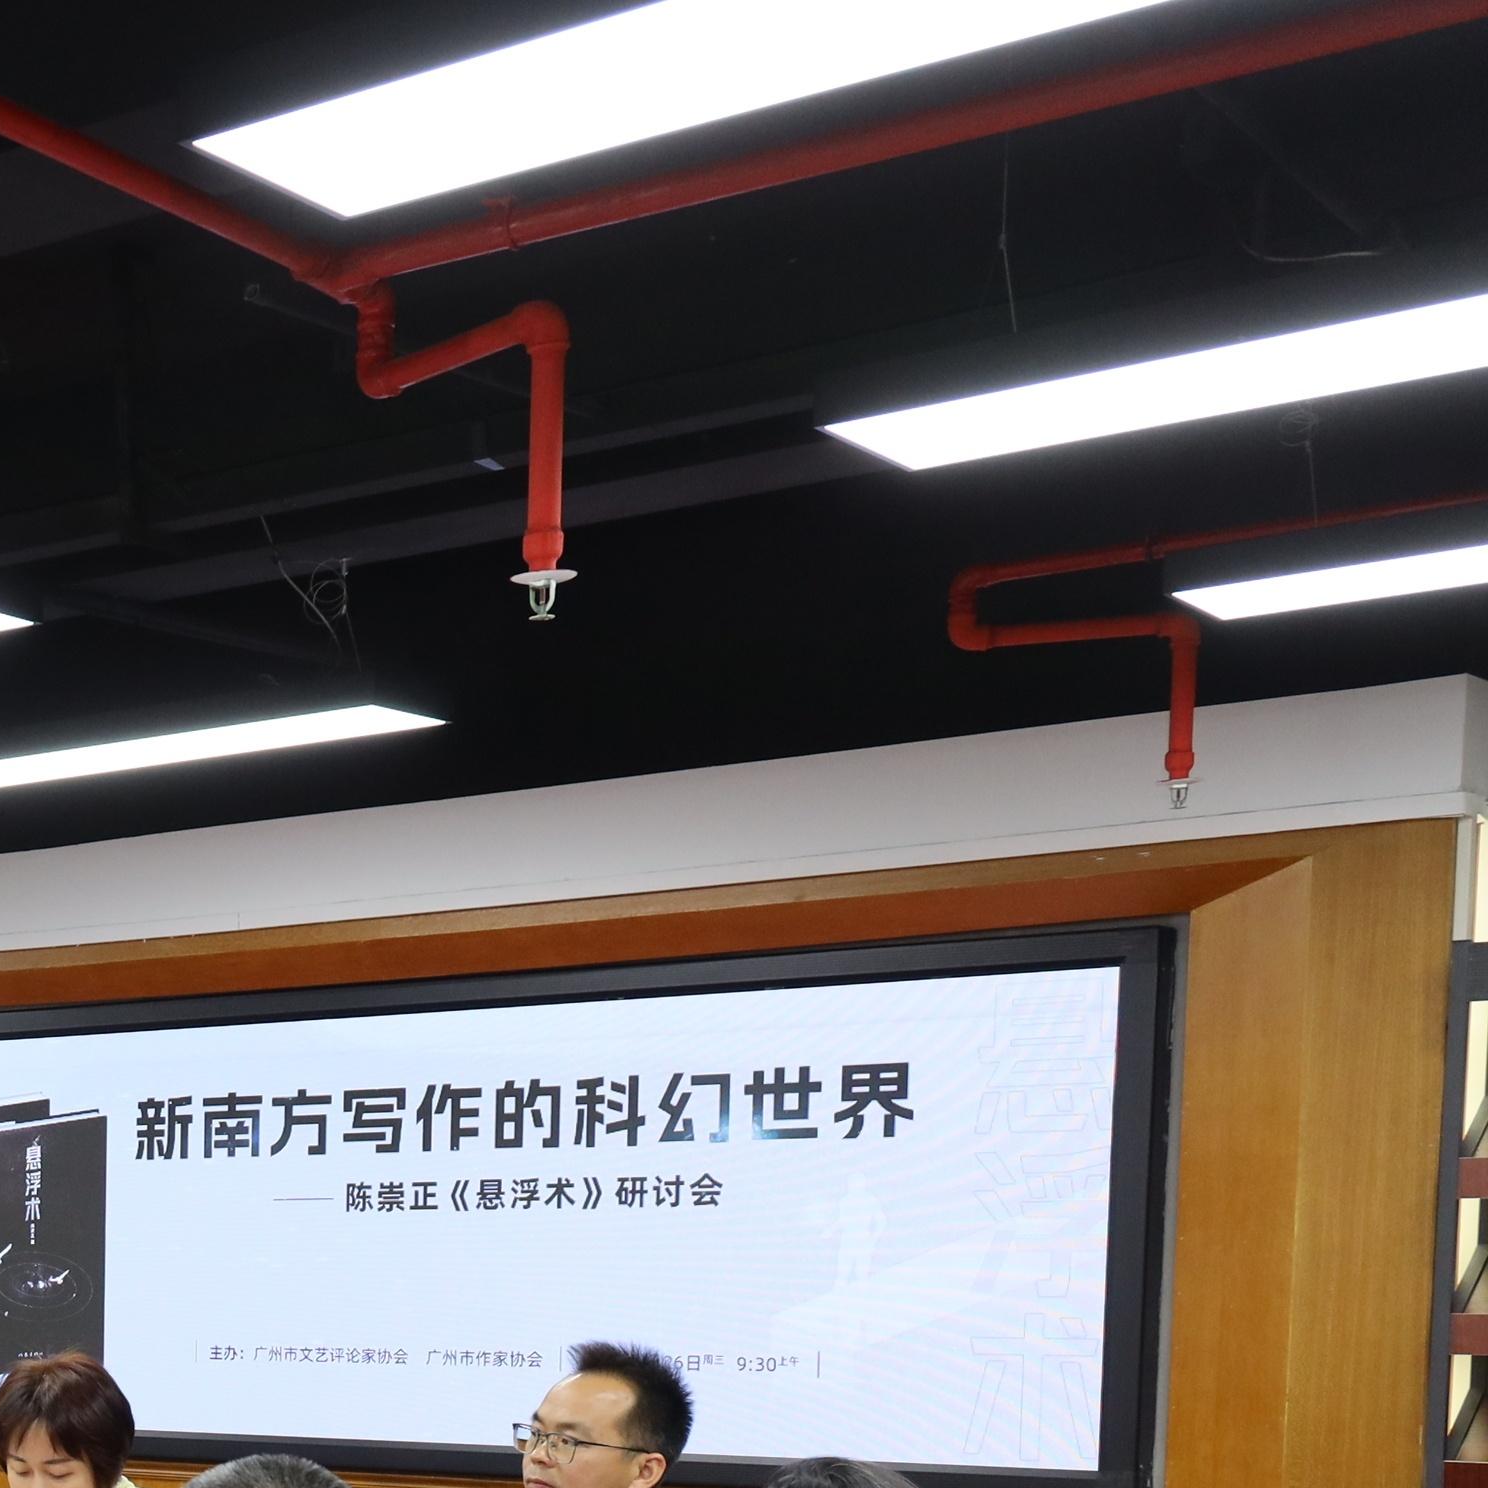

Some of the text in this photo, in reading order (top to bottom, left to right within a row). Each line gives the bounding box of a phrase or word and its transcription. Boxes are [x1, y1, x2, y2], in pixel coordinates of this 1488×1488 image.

[135, 1062, 914, 1160] 新南方写作的科幻世界
[25, 1145, 42, 1221] 悬浮术
[426, 1349, 543, 1368] 广州市作家协会
